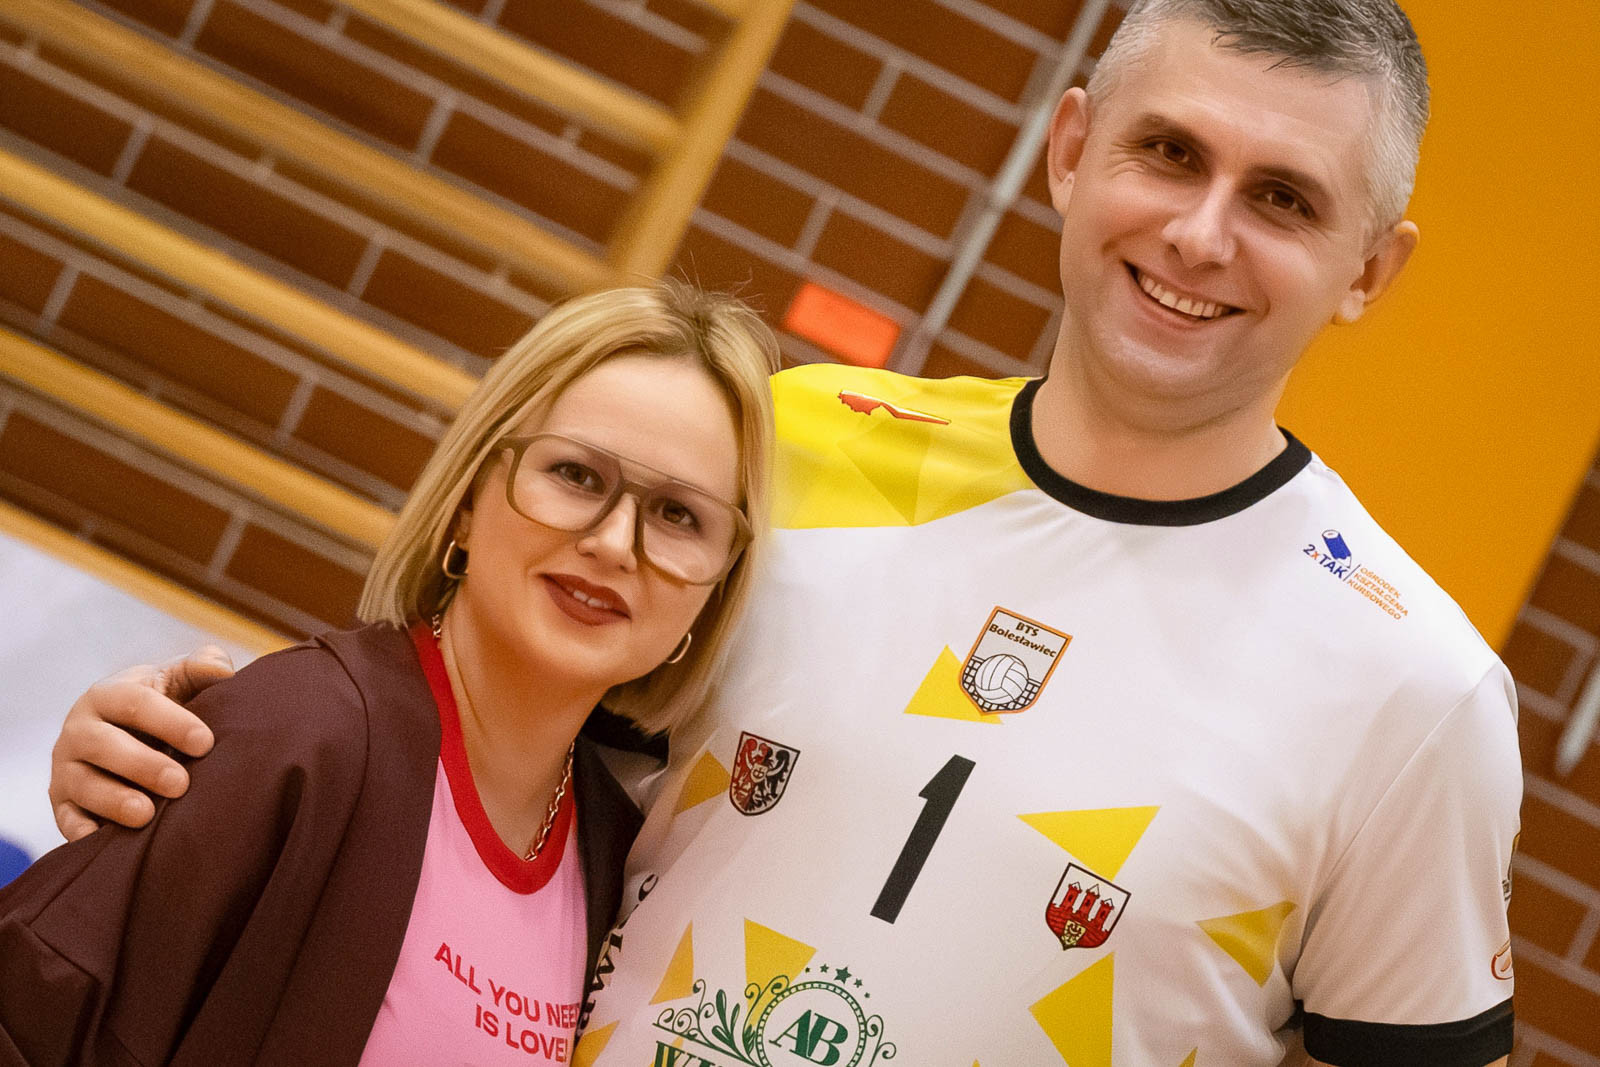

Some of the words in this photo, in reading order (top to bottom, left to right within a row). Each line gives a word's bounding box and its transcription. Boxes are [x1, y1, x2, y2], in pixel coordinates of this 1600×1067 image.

[1347, 579, 1402, 620] KURSOWEGO
[1353, 572, 1409, 616] KSZTAŁCENIA
[989, 623, 1057, 658] Bolesławiec
[1016, 621, 1040, 637] BTS
[870, 754, 976, 924] 1
[434, 942, 481, 995] ALL
[488, 978, 540, 1022] YOU
[475, 1003, 499, 1037] IS
[768, 1009, 849, 1067] AB
